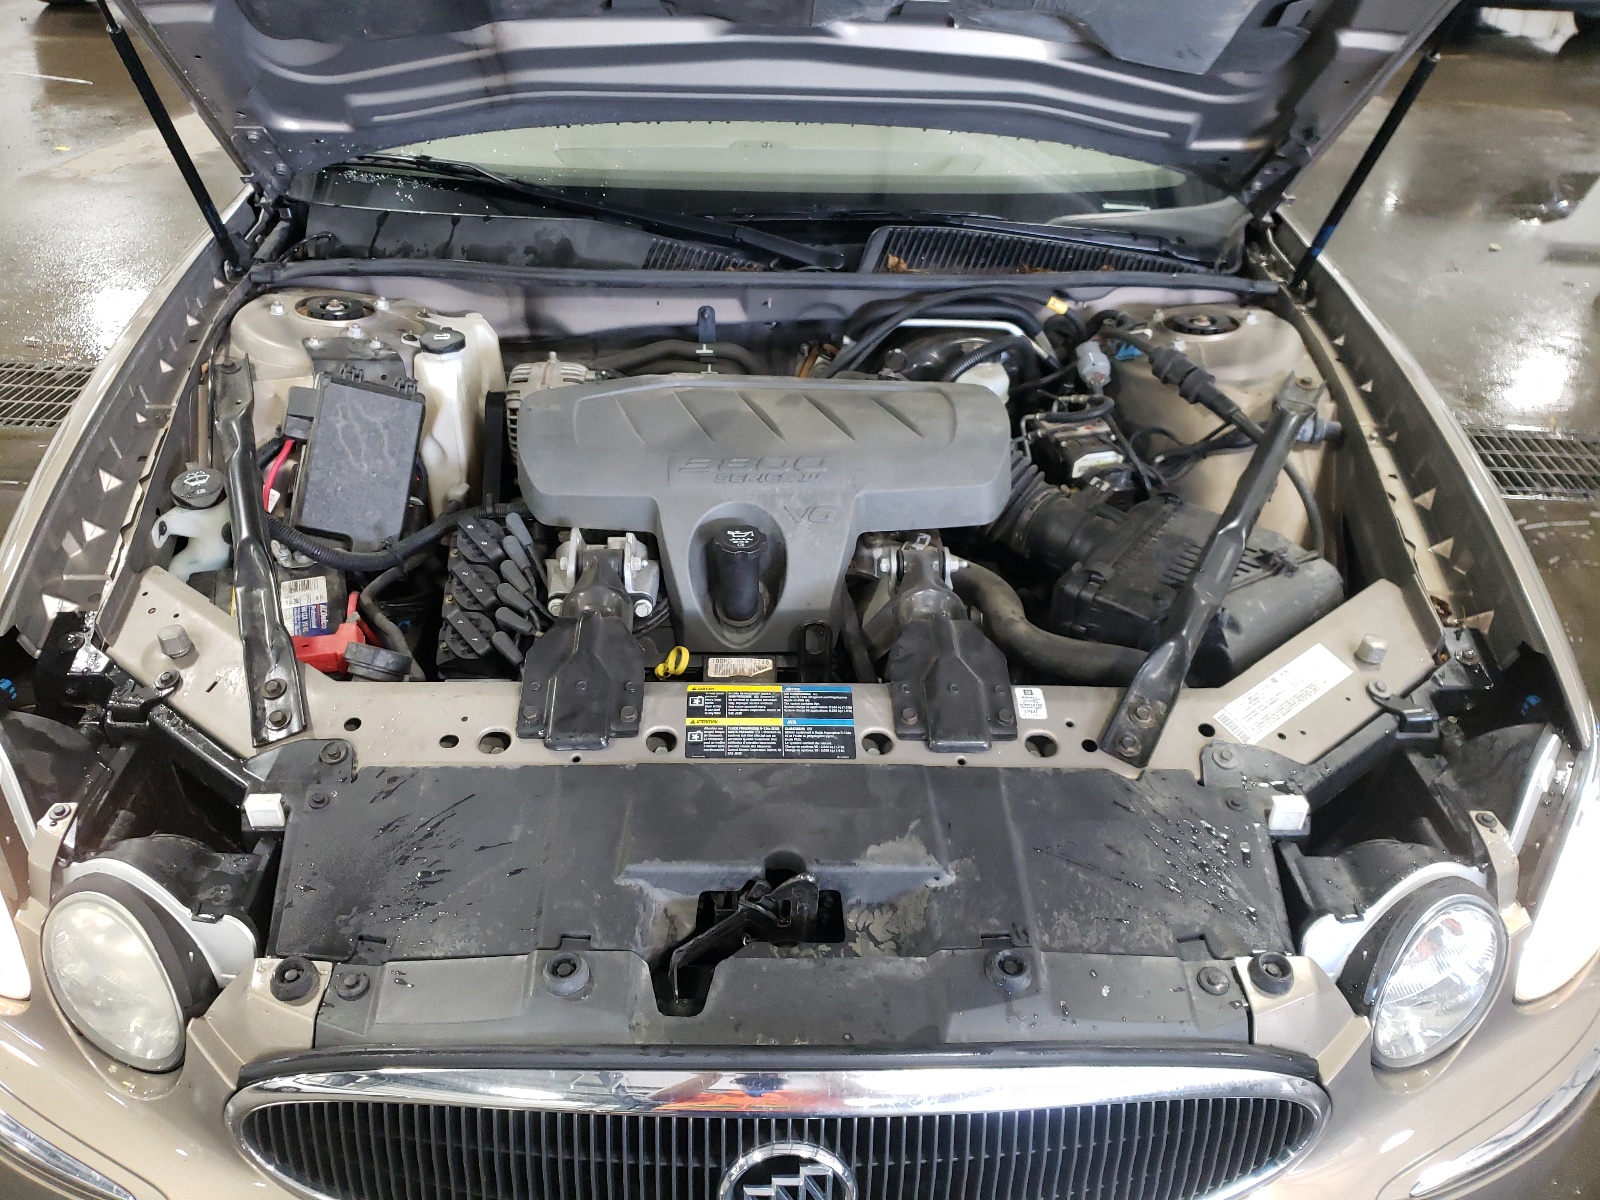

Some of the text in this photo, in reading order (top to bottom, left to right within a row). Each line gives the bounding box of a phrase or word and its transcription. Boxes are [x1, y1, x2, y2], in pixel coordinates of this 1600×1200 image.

[678, 456, 827, 473] 3800
[714, 472, 794, 484] SERIES
[783, 505, 837, 523] V6
